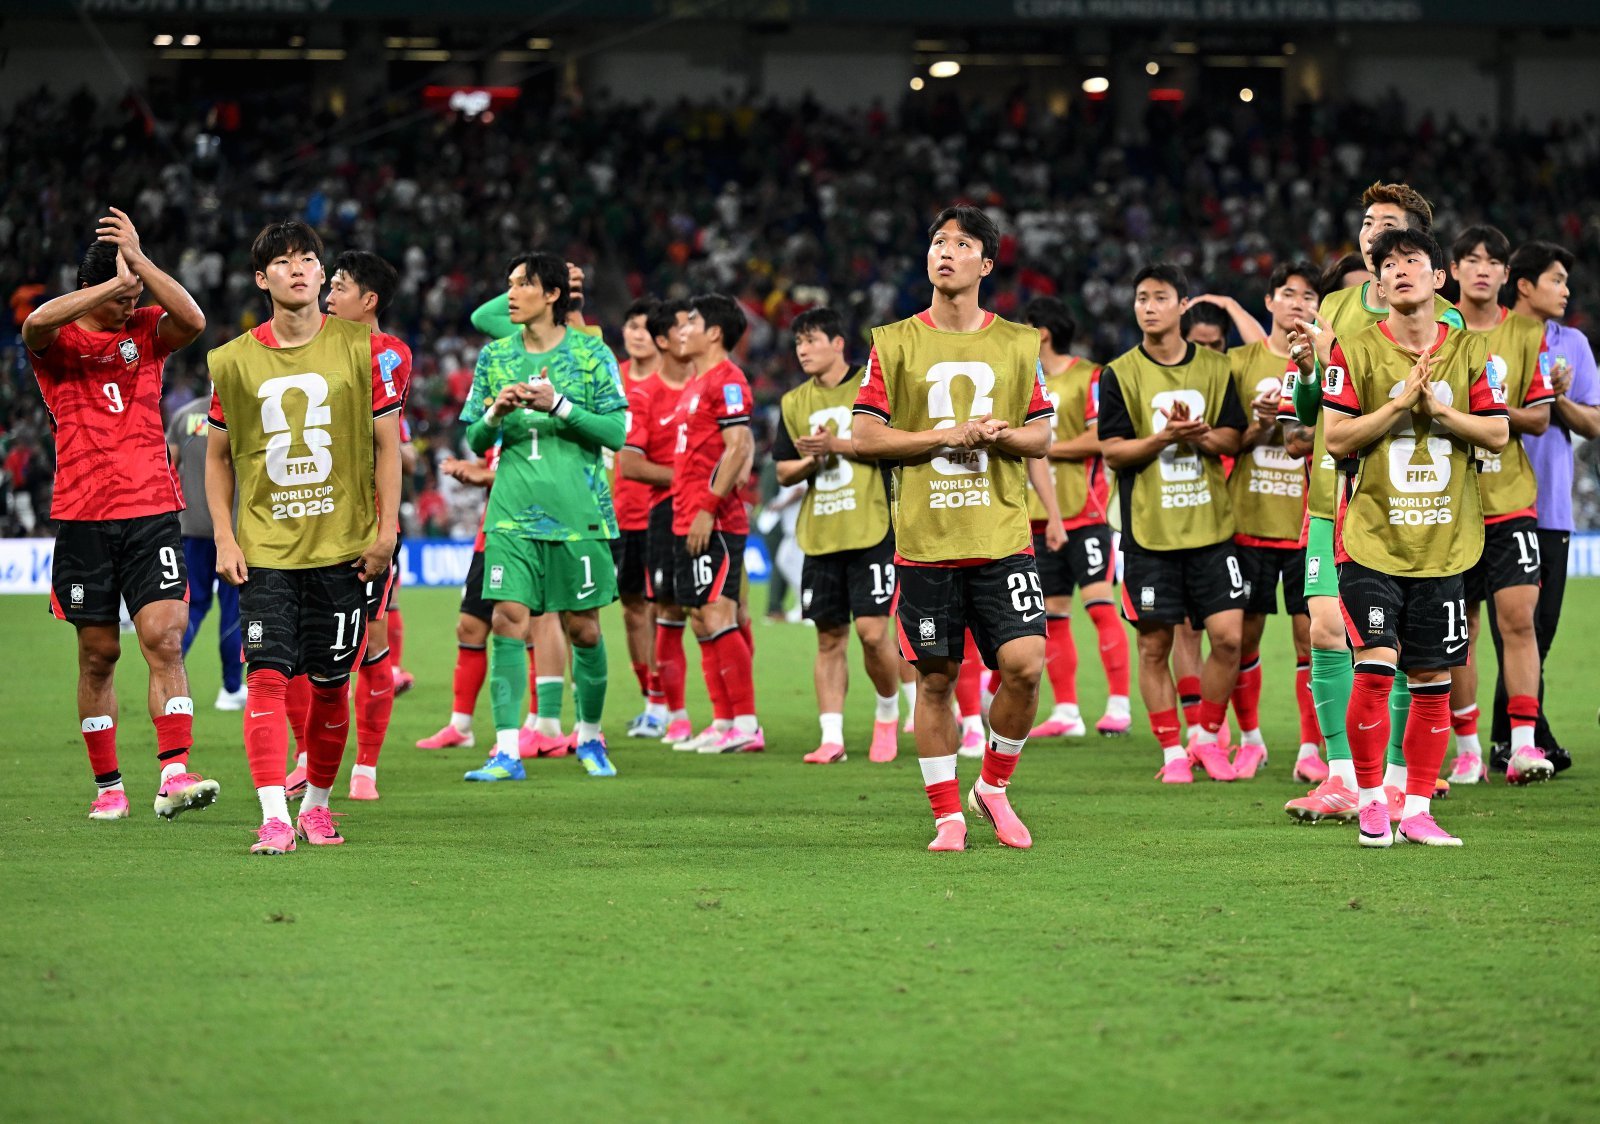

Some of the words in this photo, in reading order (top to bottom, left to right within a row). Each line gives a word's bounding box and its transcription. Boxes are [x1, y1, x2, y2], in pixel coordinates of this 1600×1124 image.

[102, 382, 125, 413] 9
[527, 427, 543, 461] 1
[286, 461, 319, 476] FIFA
[948, 451, 980, 465] FIFA
[929, 480, 973, 491] WORLD
[1406, 470, 1439, 483] FIFA
[271, 489, 314, 503] WORLD
[314, 485, 334, 499] CUP
[929, 491, 991, 509] 2026
[1161, 490, 1212, 509] 2026
[1249, 479, 1303, 498] 2026
[272, 498, 335, 521] 2026
[1389, 497, 1431, 508] WORLD
[1433, 496, 1451, 507] CUP
[1388, 508, 1453, 526] 2026
[158, 546, 180, 580] 9
[1084, 537, 1104, 567] 5
[580, 555, 596, 589] 1
[692, 554, 714, 588] 16
[868, 563, 896, 596] 13
[1226, 555, 1243, 589] 8
[1007, 571, 1046, 613] 25
[1442, 598, 1470, 643] 15
